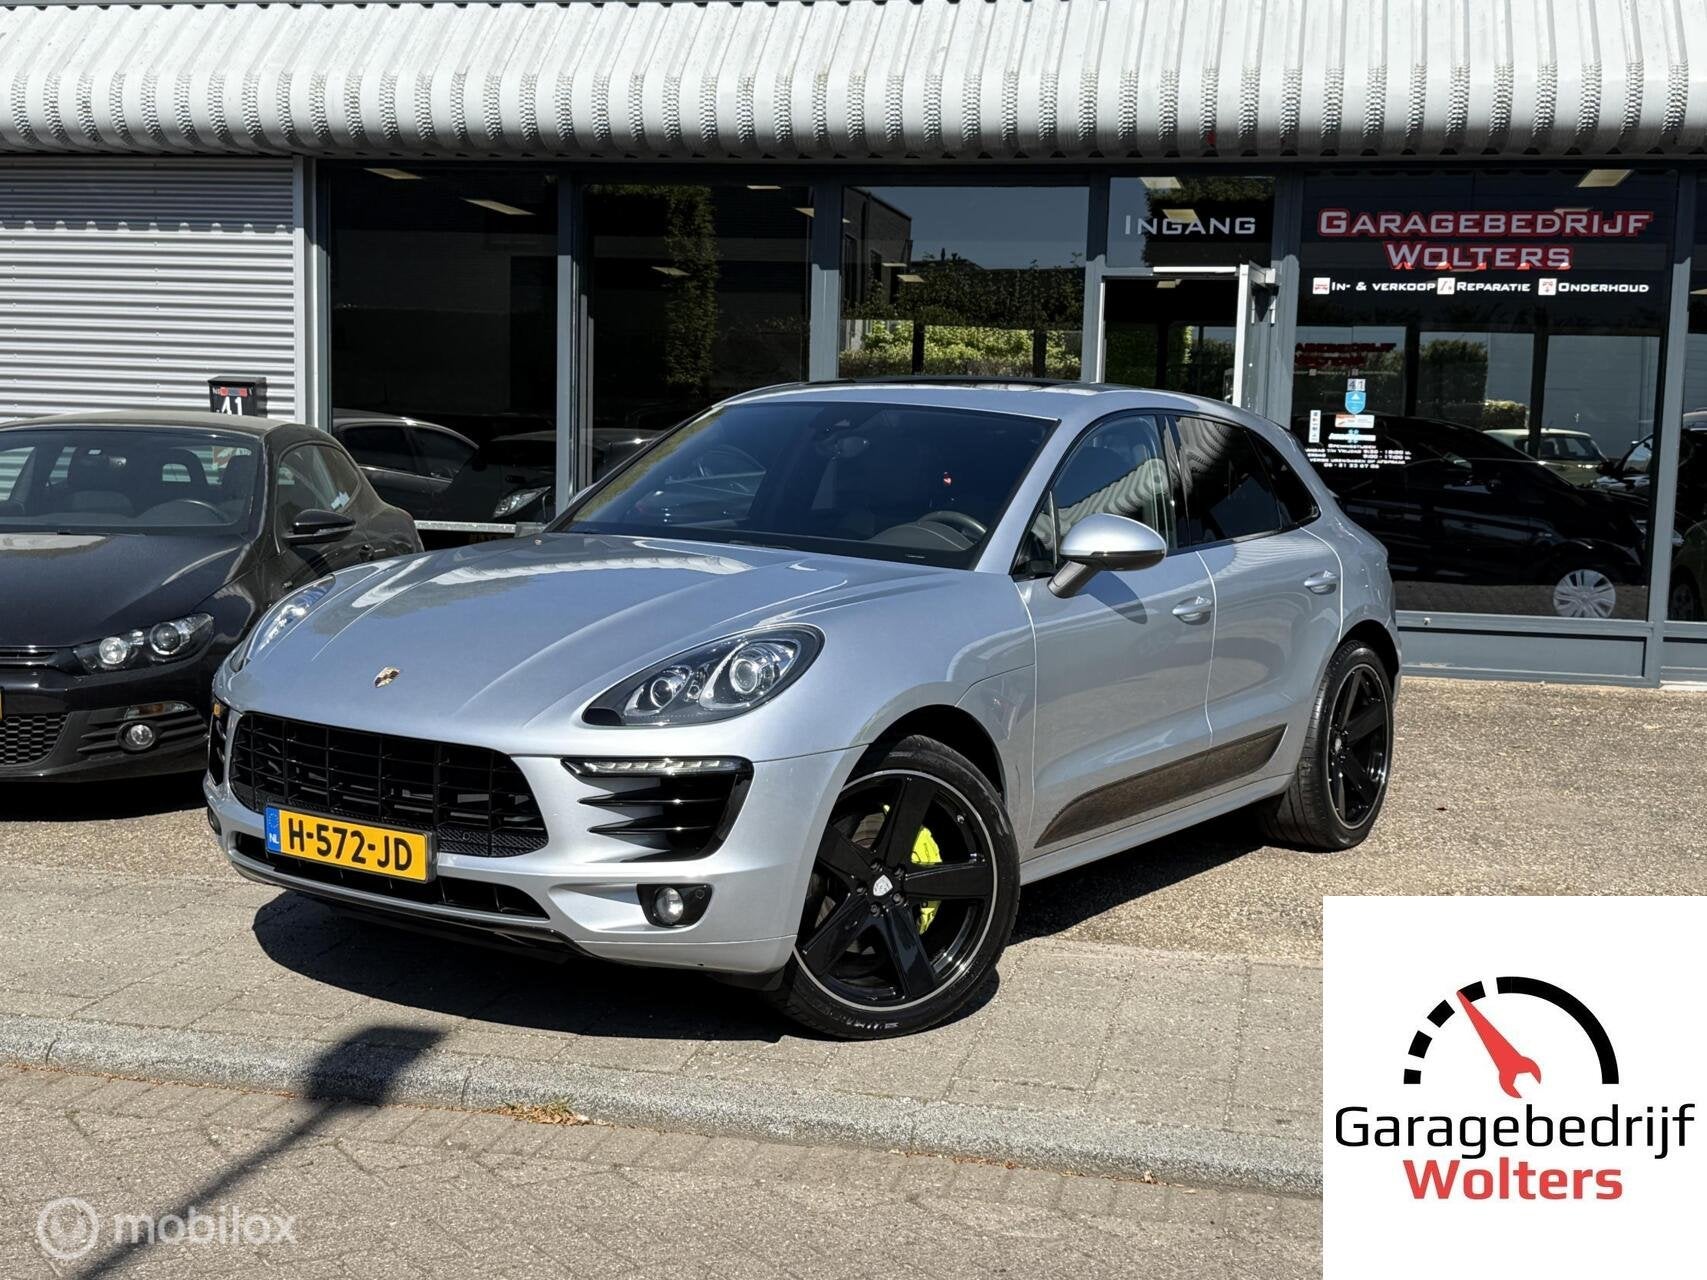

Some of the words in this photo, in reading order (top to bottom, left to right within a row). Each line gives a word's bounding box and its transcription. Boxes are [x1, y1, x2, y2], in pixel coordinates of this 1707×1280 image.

[1125, 215, 1256, 235] INGANG
[1319, 209, 1653, 237] GARAGEBEDRIJF
[1386, 243, 1572, 270] WOLTERS
[1356, 282, 1367, 292] &
[1372, 282, 1436, 292] VERKOOP
[1456, 281, 1531, 292] REPARATIE
[1558, 282, 1650, 293] ONDERHOUD
[269, 832, 279, 844] NL
[288, 818, 413, 871] H-572-JD
